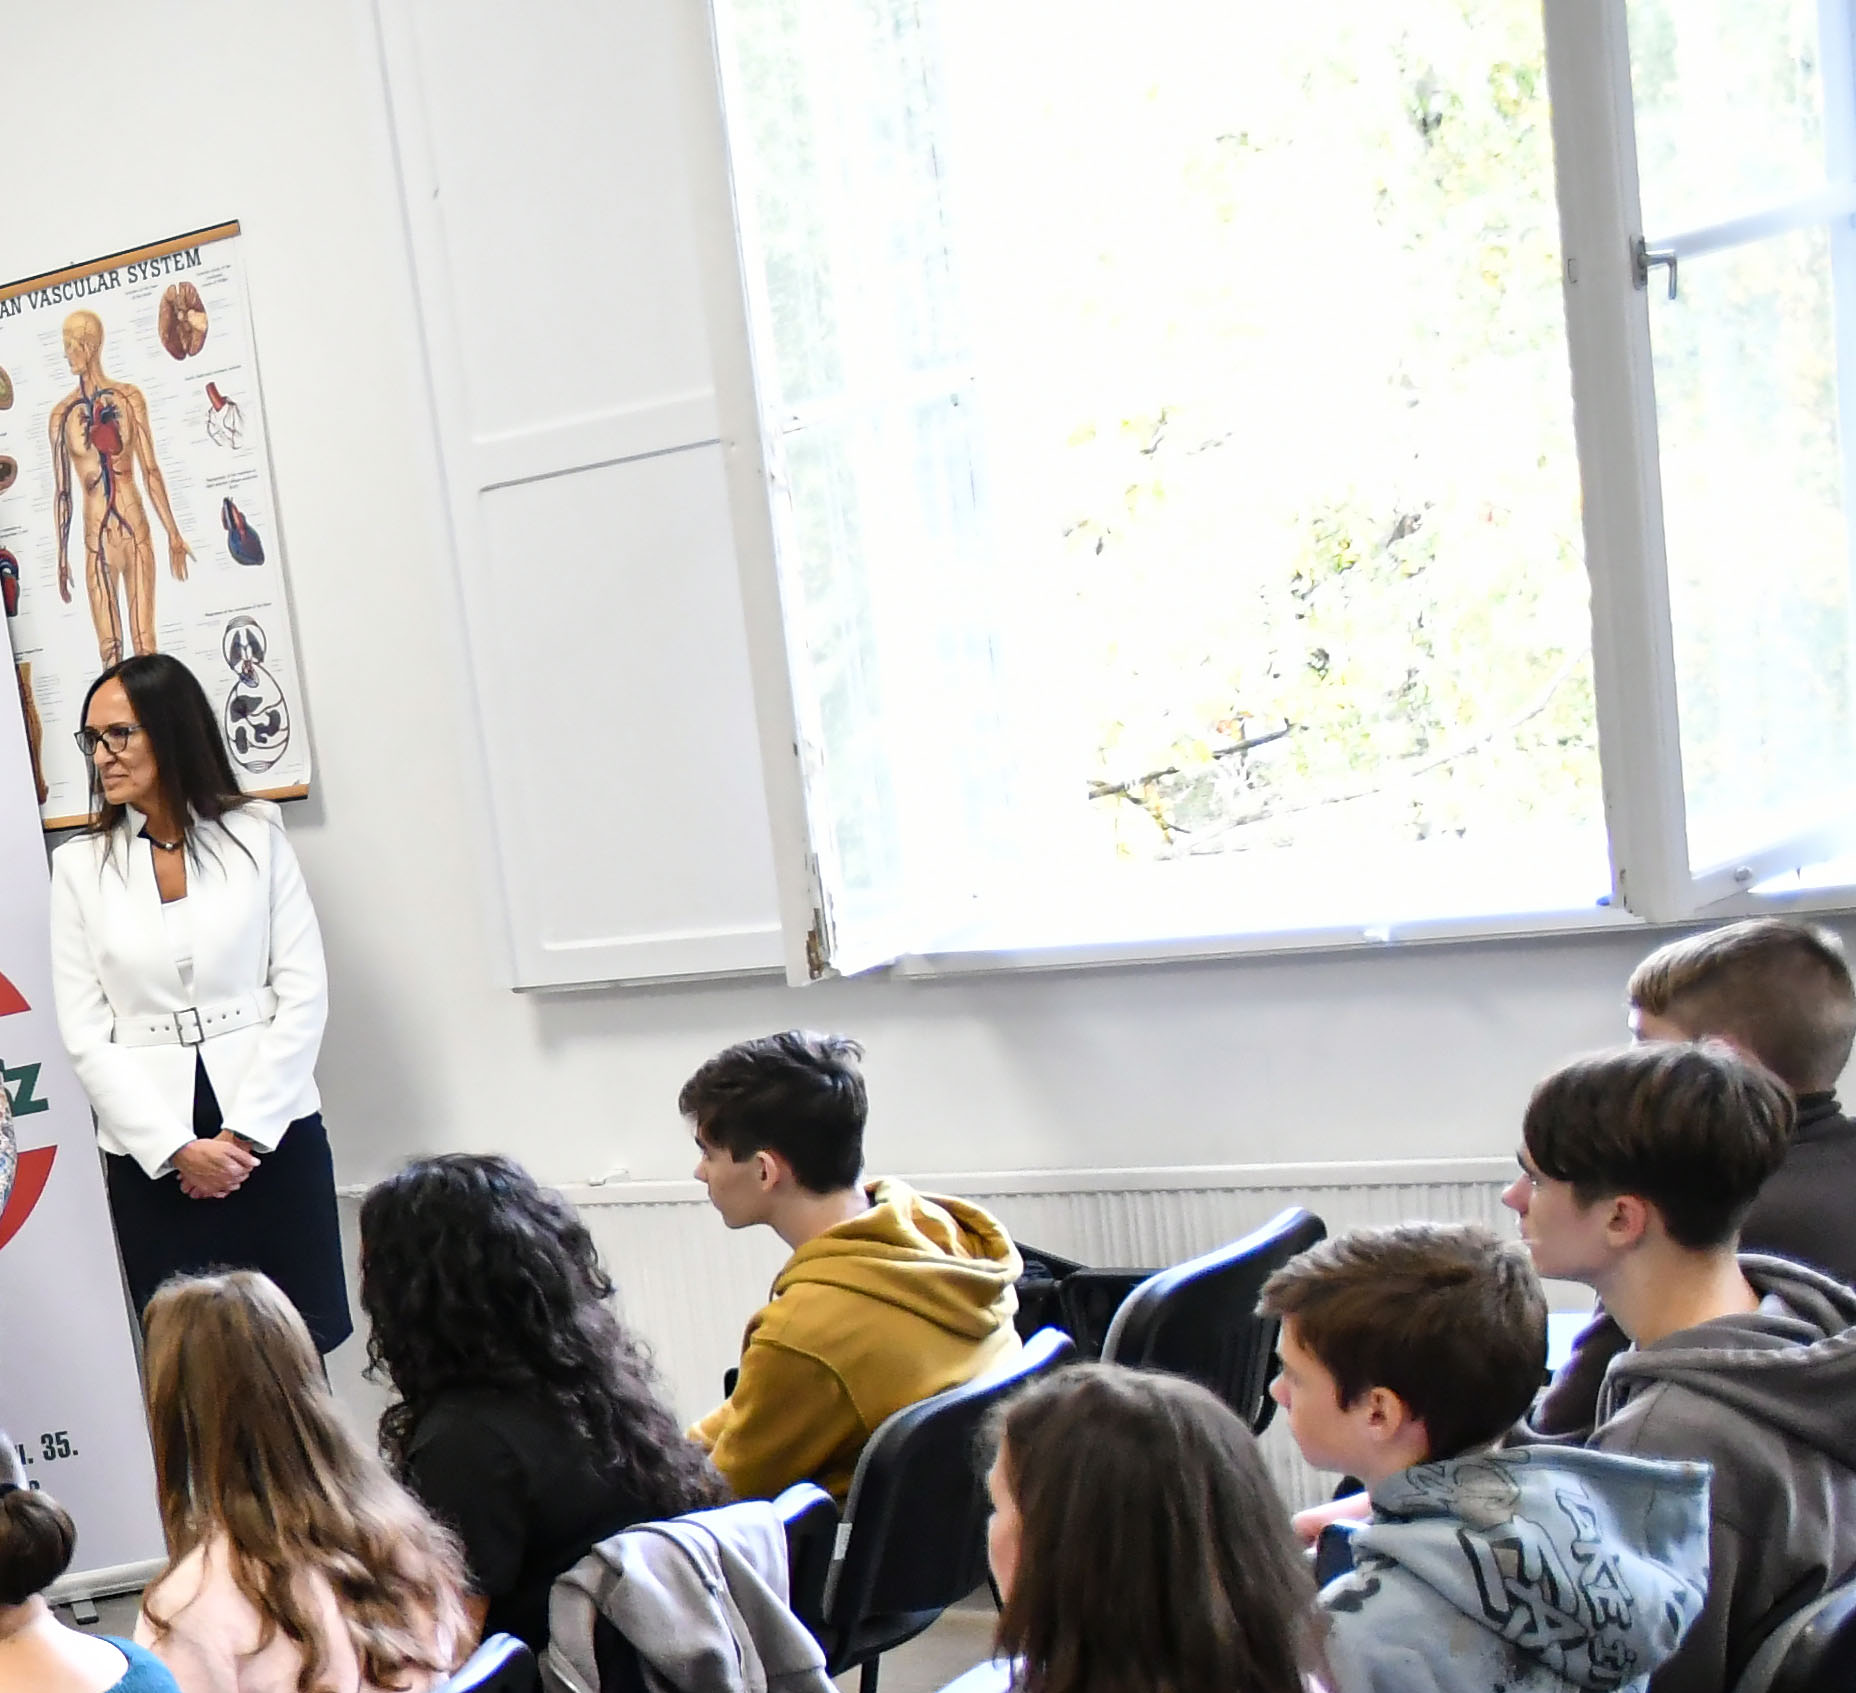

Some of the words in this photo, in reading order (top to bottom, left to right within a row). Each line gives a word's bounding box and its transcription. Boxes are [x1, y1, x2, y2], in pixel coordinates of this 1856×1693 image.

[26, 270, 121, 311] VASCULAR
[127, 247, 202, 285] SYSTEM
[40, 1431, 79, 1461] 35.
